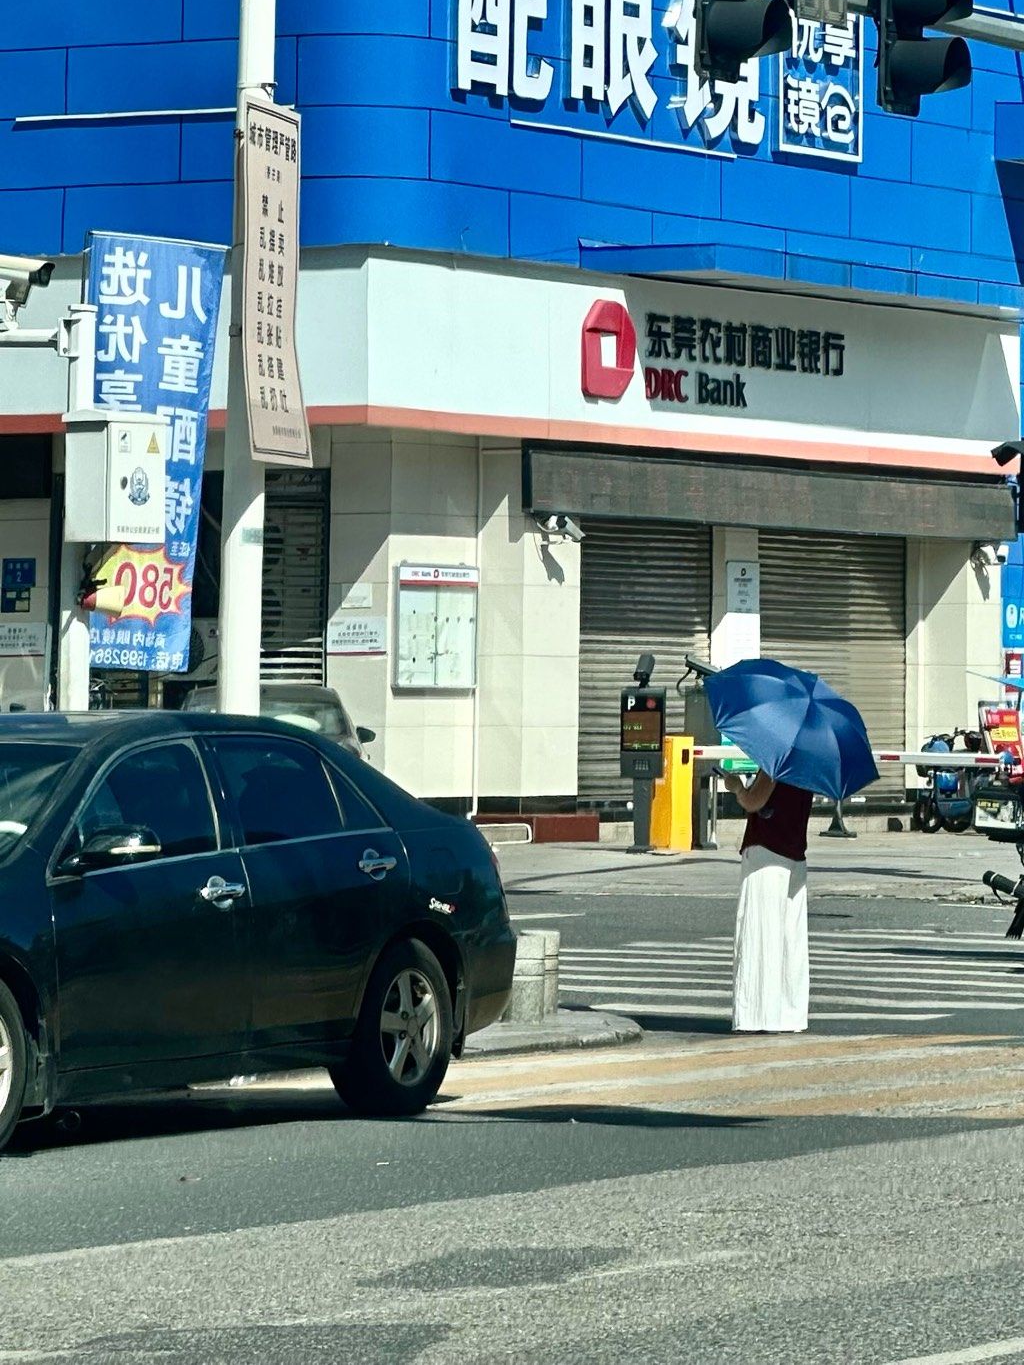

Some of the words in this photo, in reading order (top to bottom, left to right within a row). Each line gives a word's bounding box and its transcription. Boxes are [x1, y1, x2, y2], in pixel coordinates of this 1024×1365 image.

[645, 313, 845, 376] 东莞农村商业银行
[645, 367, 688, 403] DRC
[697, 372, 747, 408] Bank
[627, 696, 636, 711] P
